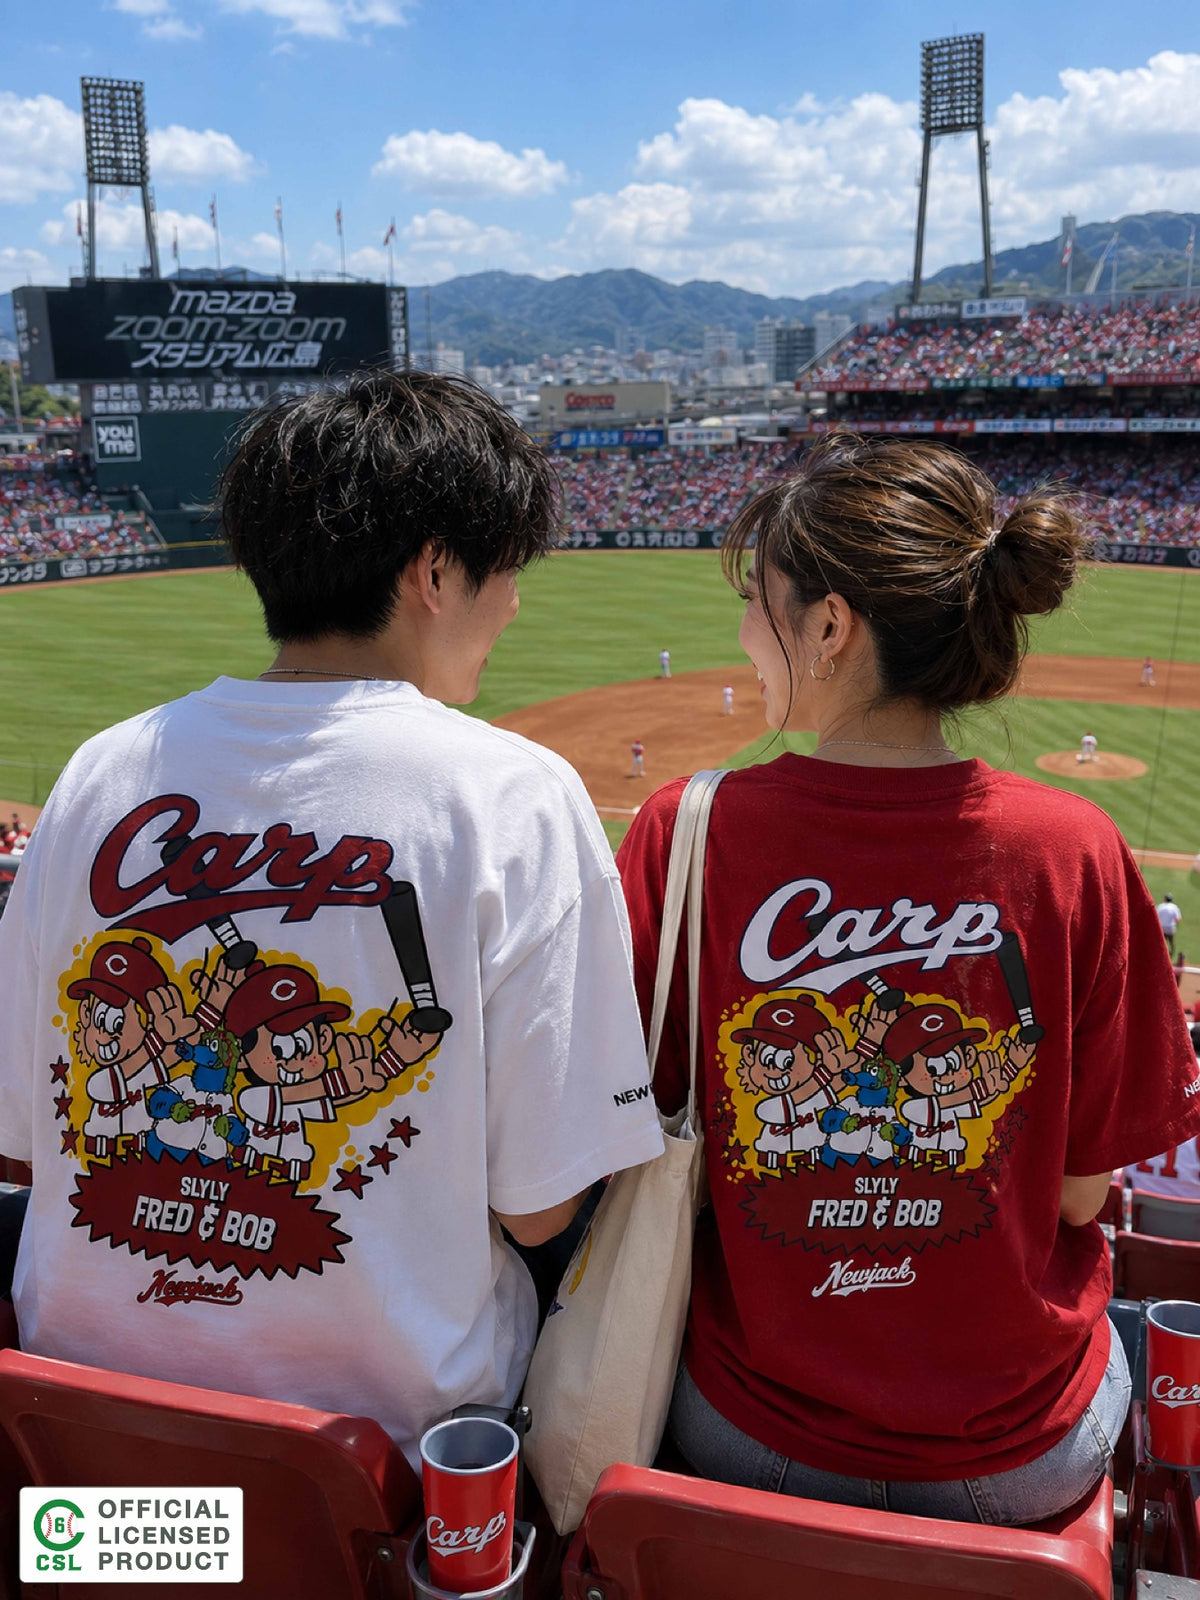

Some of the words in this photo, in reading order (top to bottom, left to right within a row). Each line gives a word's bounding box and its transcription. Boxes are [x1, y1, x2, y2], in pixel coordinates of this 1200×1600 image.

[131, 340, 323, 368] スタジアム広島
[97, 424, 133, 444] you
[104, 440, 136, 455] me
[90, 793, 395, 932] Carp
[739, 877, 1004, 982] Carp
[613, 1083, 655, 1107] NEW
[181, 1177, 231, 1202] SLYLY
[854, 1177, 899, 1195] SLYLY
[132, 1195, 194, 1234] FRED
[199, 1202, 221, 1242] &
[222, 1211, 277, 1252] BOB
[807, 1199, 868, 1228] FRED
[872, 1196, 890, 1230] &
[893, 1199, 943, 1228] BOB
[137, 1269, 243, 1307] Newjack
[811, 1256, 917, 1298] Newjack
[426, 1511, 507, 1555] Carp
